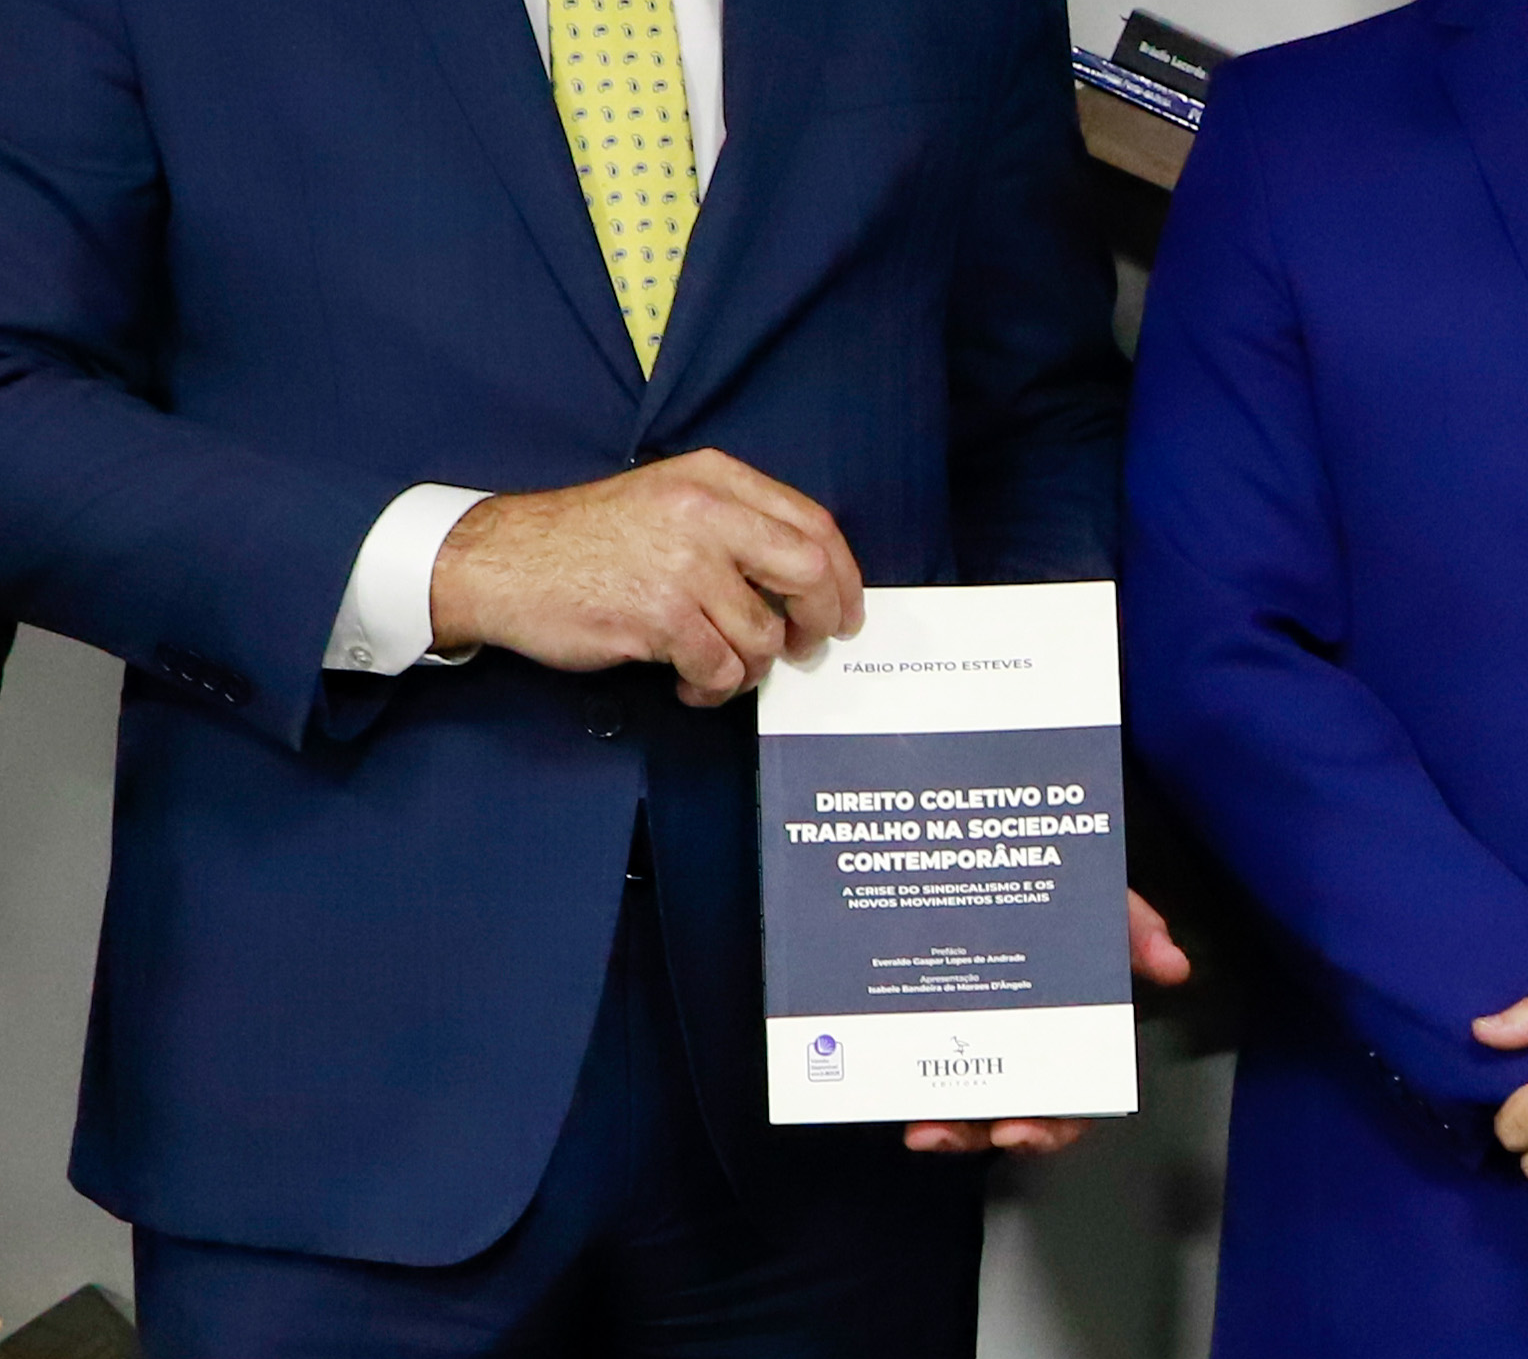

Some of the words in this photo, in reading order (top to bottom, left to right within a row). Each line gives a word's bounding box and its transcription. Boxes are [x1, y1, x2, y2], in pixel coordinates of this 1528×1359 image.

[842, 661, 894, 673] FÁBIO
[898, 661, 957, 672] PORTO
[961, 658, 1033, 671] ESTEVES
[815, 790, 915, 812] DIREITO
[919, 786, 1041, 810] COLETIVO
[1046, 784, 1084, 806] DO
[784, 820, 921, 843] TRABALHO
[926, 819, 964, 840] NA
[967, 813, 1110, 839] SOCIEDADE
[837, 842, 1061, 873] CONTEMPORÂNEA
[842, 886, 854, 897] A
[855, 885, 896, 896] CRISE
[897, 884, 920, 895] DO
[921, 881, 1021, 895] SINDICALISMO
[1022, 880, 1033, 891] E
[1034, 879, 1055, 890] OS
[848, 897, 898, 909] NOVOS
[899, 894, 993, 907] MOVIMENTOS
[994, 892, 1050, 904] SOCIAIS
[917, 1057, 1003, 1077] THOTH
